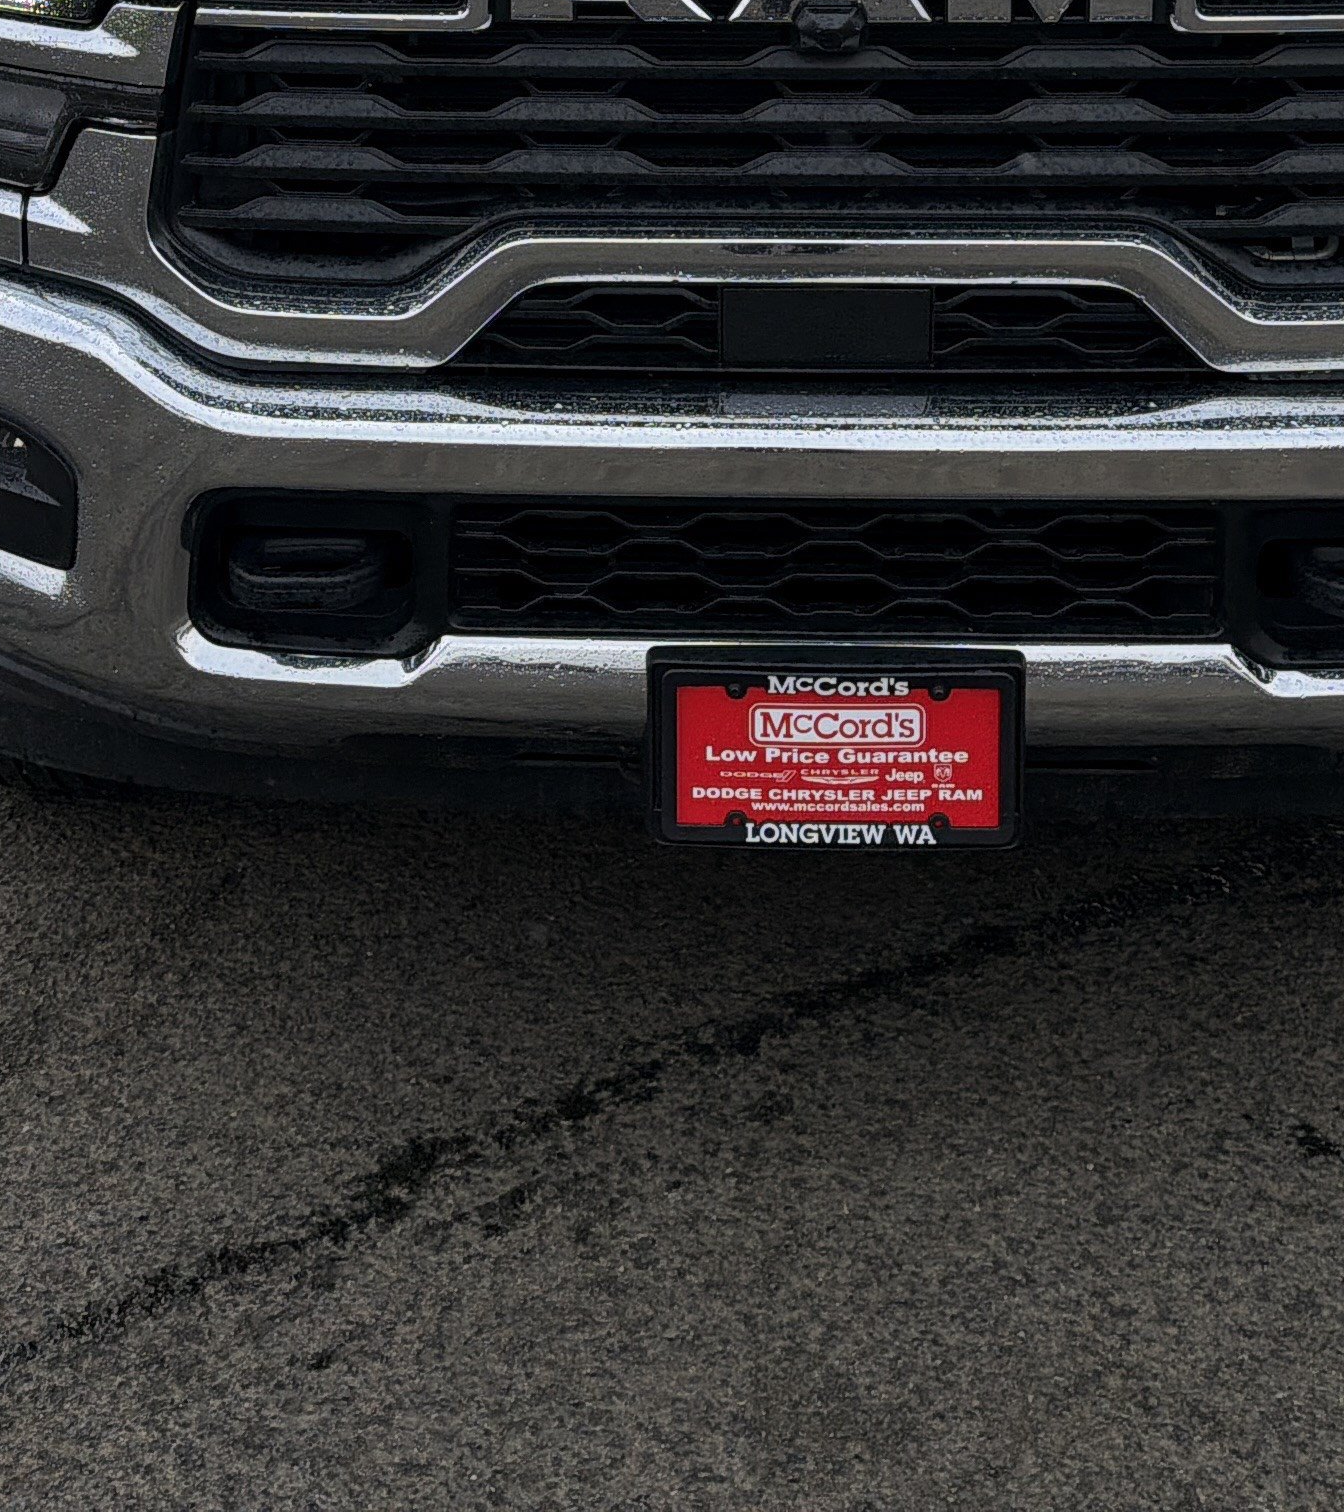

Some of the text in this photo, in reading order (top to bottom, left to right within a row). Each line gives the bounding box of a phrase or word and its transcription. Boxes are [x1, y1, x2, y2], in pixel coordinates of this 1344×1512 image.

[767, 675, 910, 697] McCord's
[759, 711, 916, 739] McCord's
[705, 746, 969, 764] Low Price Guarantee
[719, 770, 782, 780] DODGE
[800, 768, 880, 776] CHRYSLER
[885, 768, 925, 784] Jeep
[692, 787, 983, 801] DODGE CHRYSLER JEEP RAM
[751, 801, 926, 813] www.mccordsales.com
[745, 822, 937, 845] LONGVIEW WA
